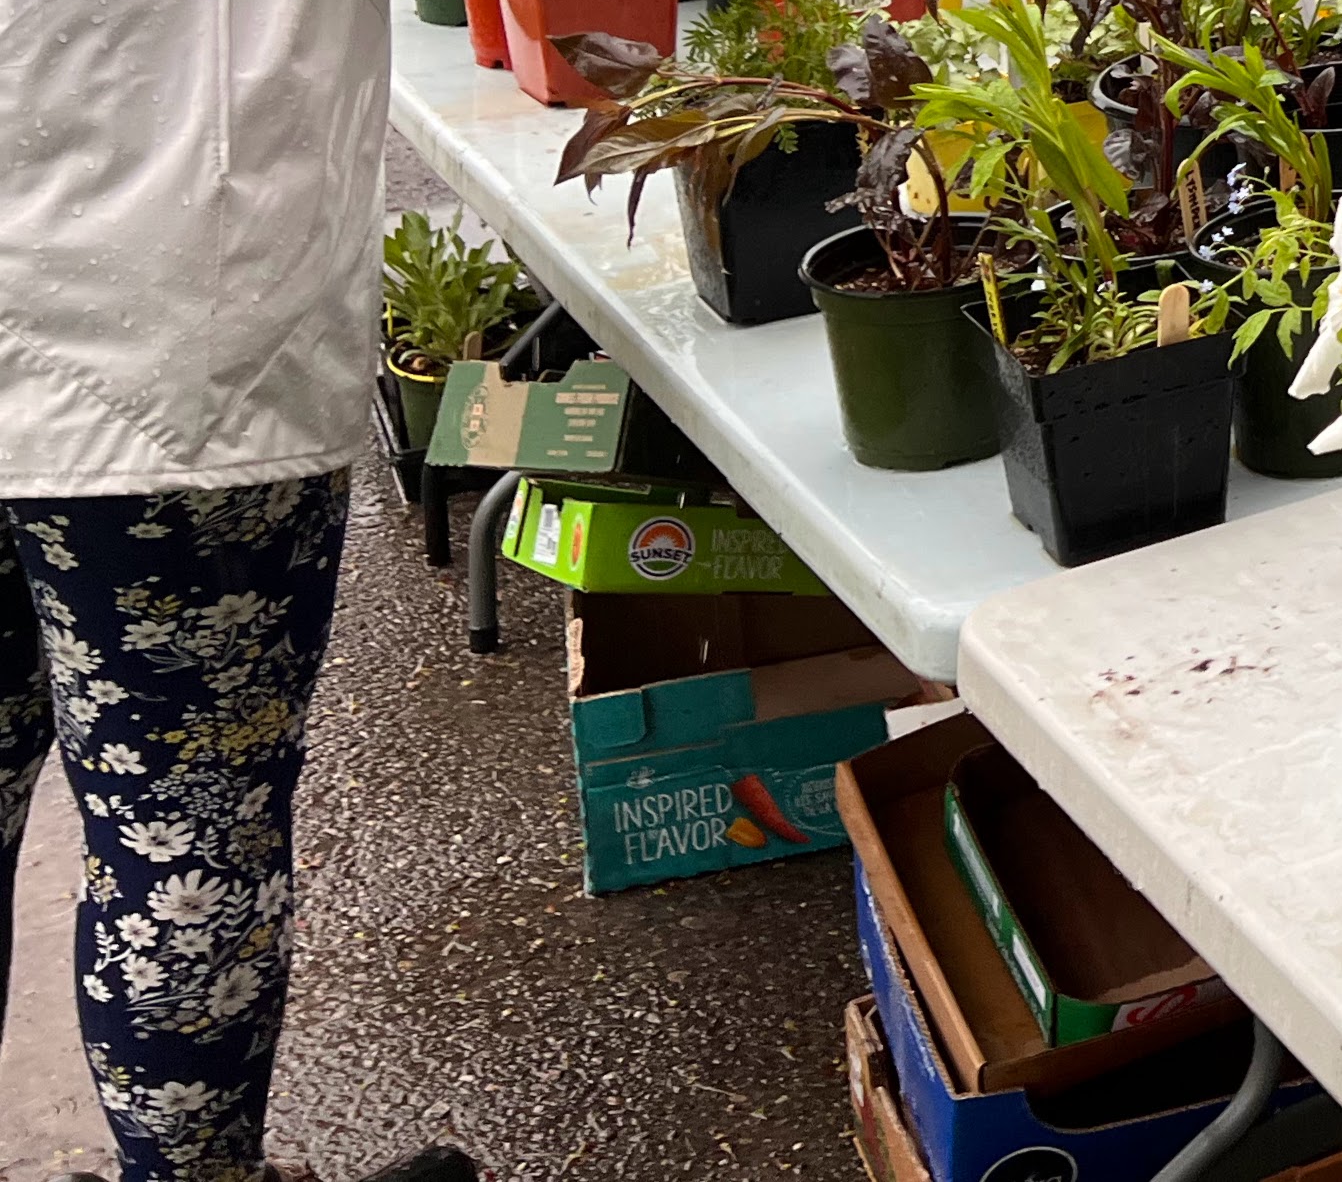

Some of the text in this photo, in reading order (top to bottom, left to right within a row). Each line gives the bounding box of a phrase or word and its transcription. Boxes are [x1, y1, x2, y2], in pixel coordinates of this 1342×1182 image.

[629, 547, 693, 564] SUNSET
[613, 783, 734, 833] INSPIRED
[624, 817, 729, 865] FLAVOR
